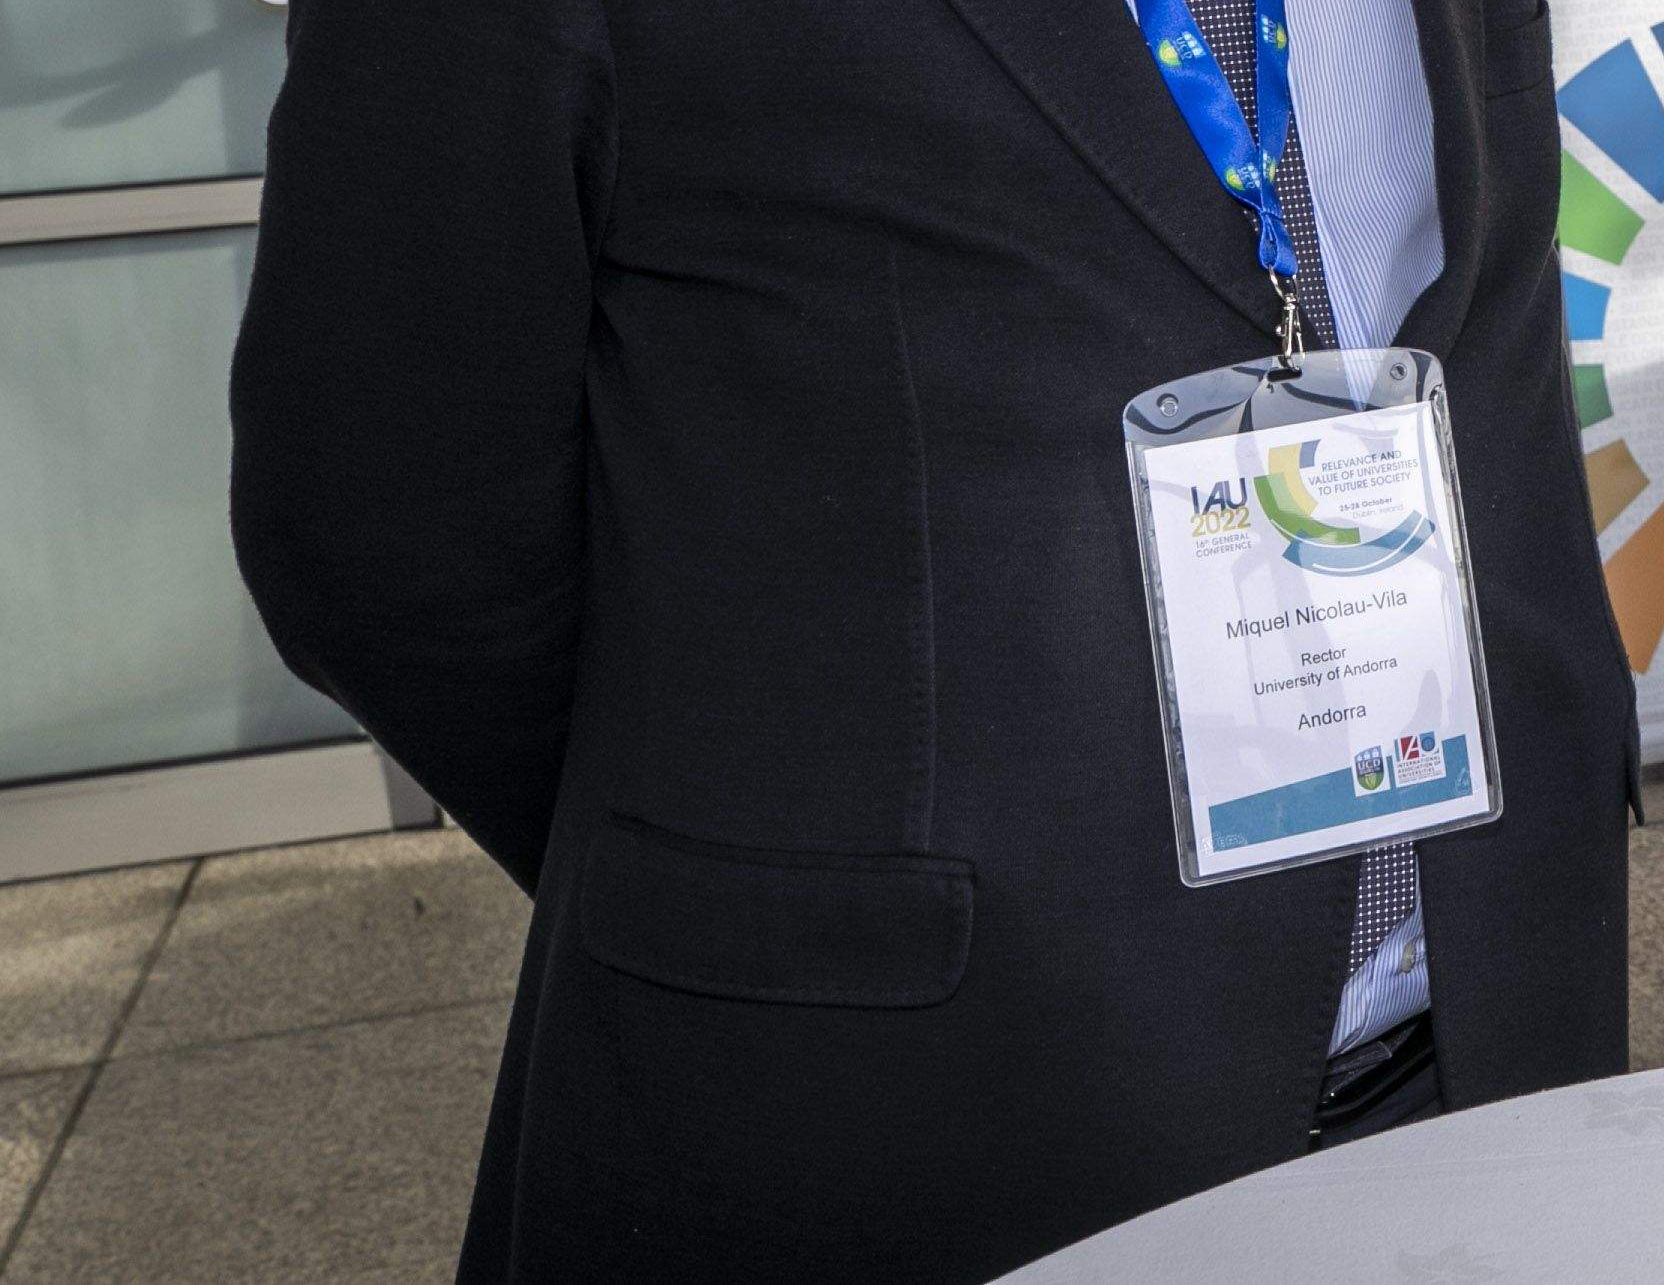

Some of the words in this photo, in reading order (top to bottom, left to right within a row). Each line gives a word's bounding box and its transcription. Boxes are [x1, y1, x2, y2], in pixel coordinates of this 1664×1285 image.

[1308, 469, 1339, 486] VALUE
[1341, 469, 1354, 481] OF
[1356, 459, 1419, 478] UNIVERSITIES
[1321, 454, 1378, 472] RELEVANCE
[1380, 450, 1402, 462] AND
[1190, 477, 1249, 516] IAU
[1318, 484, 1332, 497] TO
[1334, 479, 1369, 494] FUTURE
[1370, 472, 1412, 487] SOCIETY
[1361, 497, 1393, 510] October
[1190, 506, 1251, 537] 2022
[1195, 541, 1253, 558] CONFERENCE
[1211, 533, 1250, 548] GENERAL
[1226, 611, 1290, 640] Miquel
[1295, 590, 1408, 626] Nicolau-Vila
[1300, 647, 1347, 666] Rector
[1253, 672, 1323, 696] University
[1327, 666, 1342, 681] of
[1343, 657, 1398, 678] Andorra
[1298, 704, 1367, 730] Andorra
[1357, 758, 1381, 771] UCD
